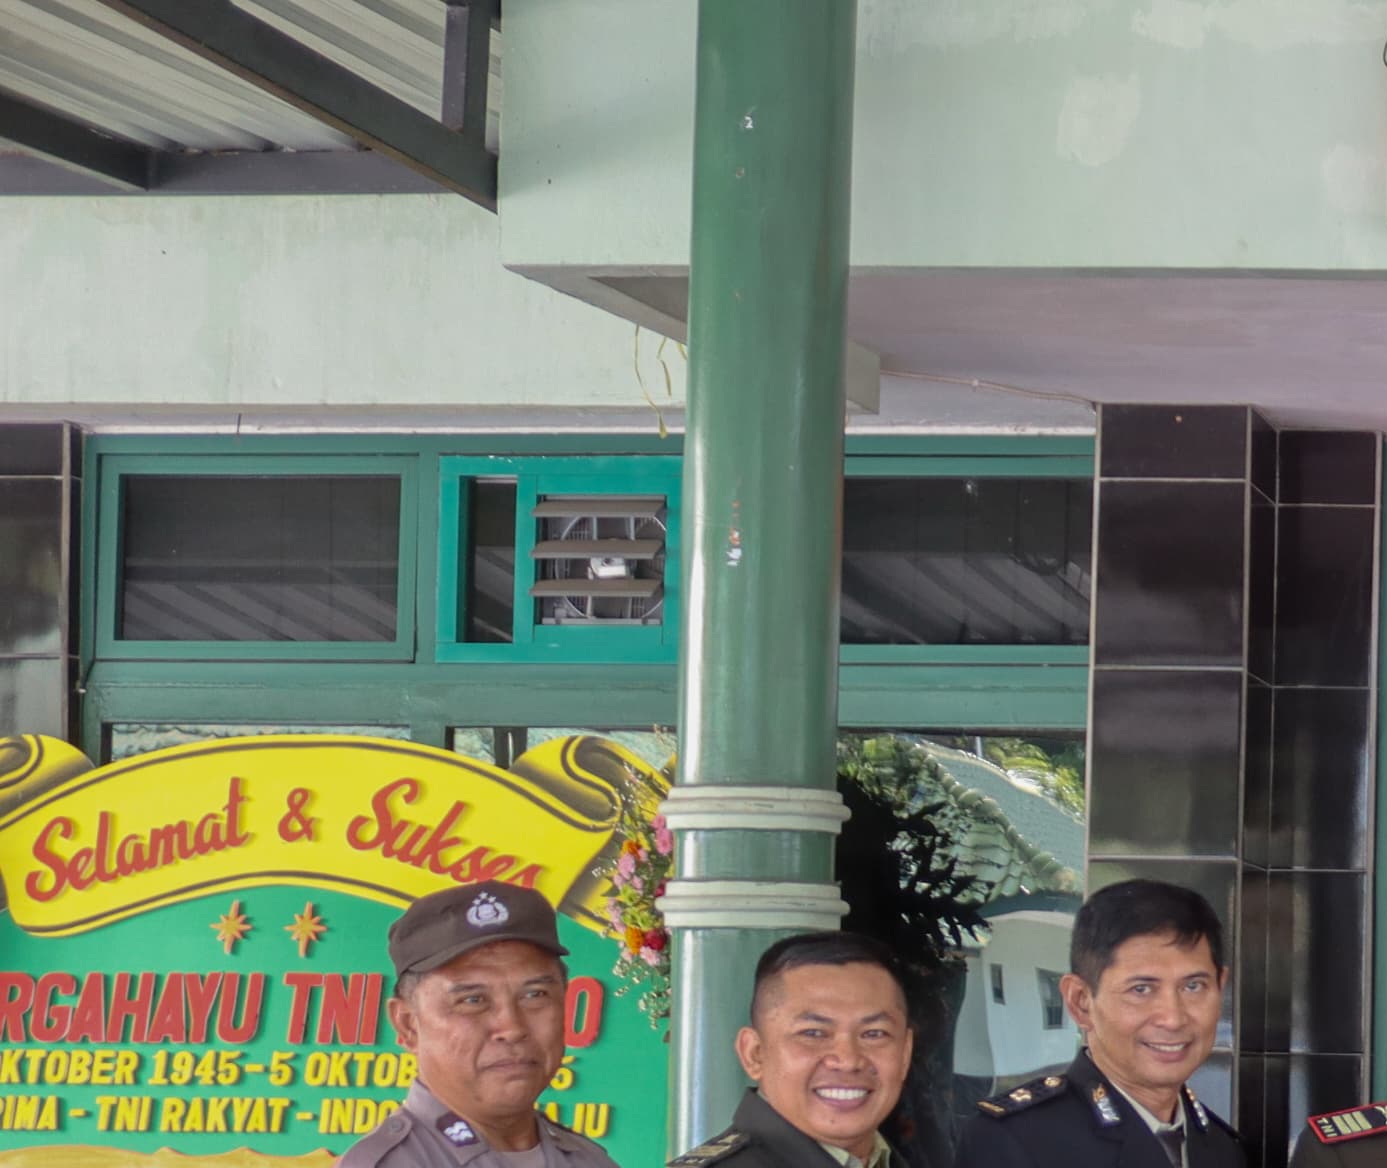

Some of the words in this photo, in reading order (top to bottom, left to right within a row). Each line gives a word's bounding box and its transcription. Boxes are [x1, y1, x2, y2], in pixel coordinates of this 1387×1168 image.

[24, 777, 251, 901] Selamat
[278, 787, 320, 842] &
[0, 971, 265, 1045] RGAHAYU
[283, 972, 384, 1046] TNI
[0, 1048, 140, 1085] KTOBER
[0, 1094, 59, 1131] IMA
[96, 1095, 152, 1132] TNI
[160, 1097, 290, 1133] RAKYAT
